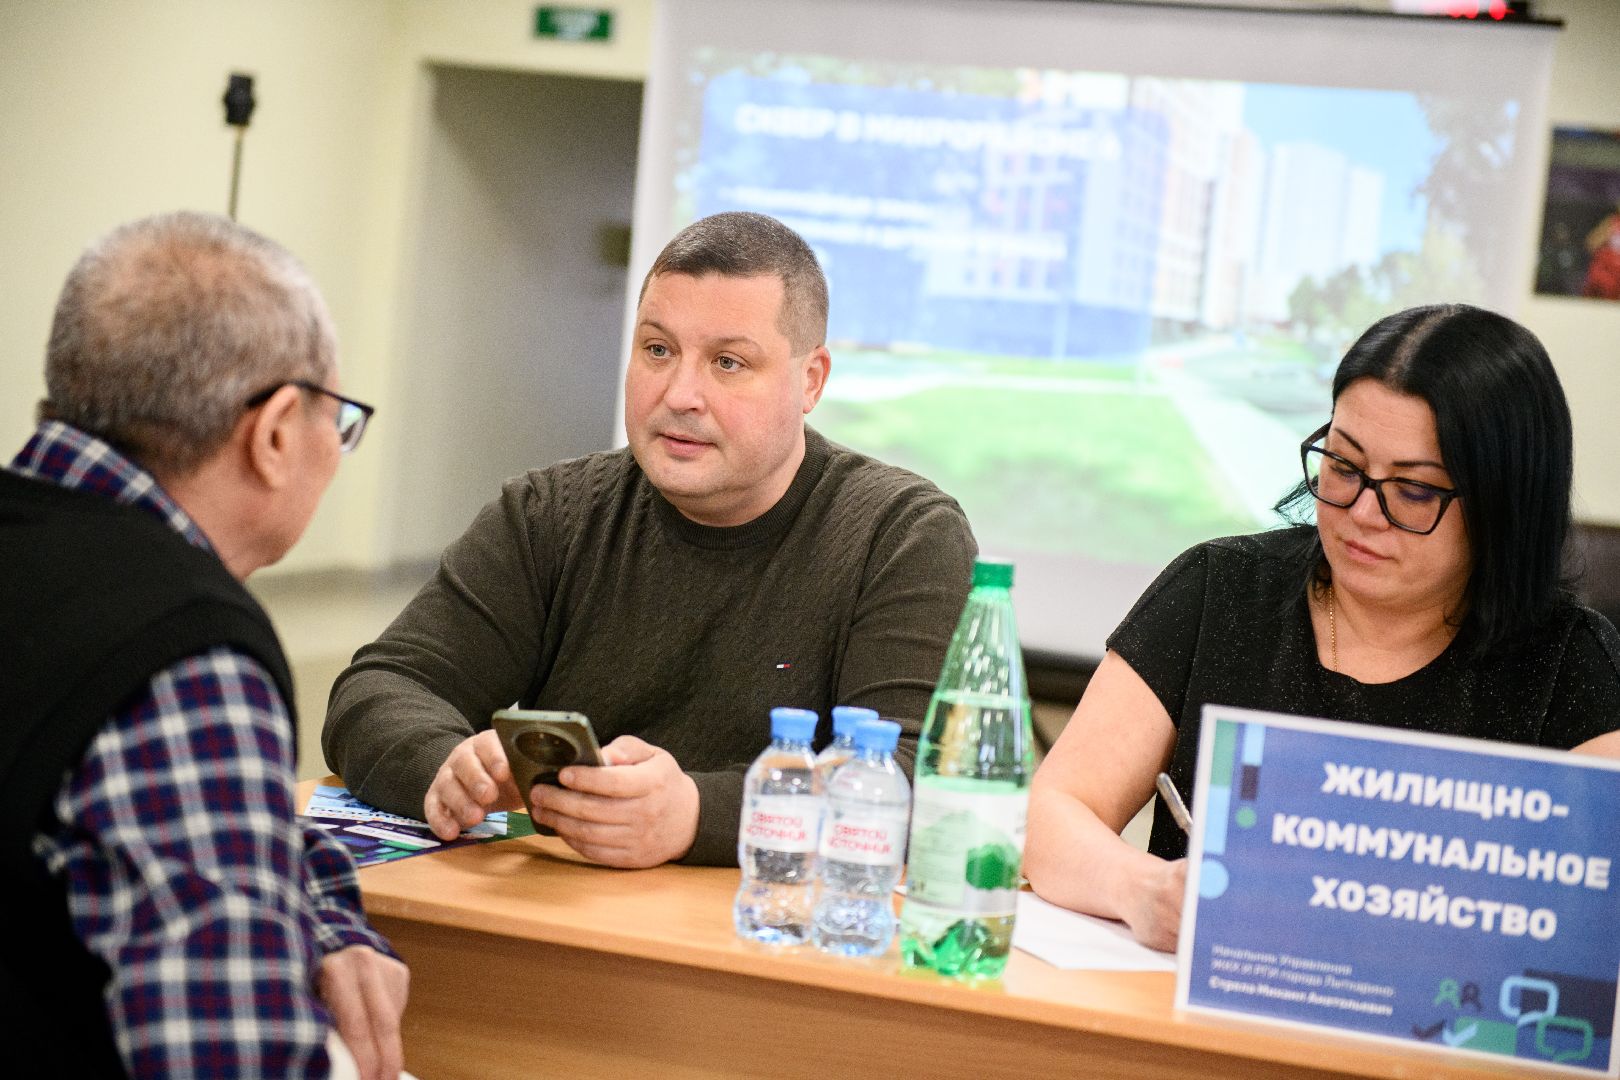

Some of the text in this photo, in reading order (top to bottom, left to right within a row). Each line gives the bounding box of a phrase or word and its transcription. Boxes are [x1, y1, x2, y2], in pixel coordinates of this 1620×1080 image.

[1321, 762, 1569, 821] ЖИЛИЩНО-
[1271, 813, 1612, 890] КОММУНАЛЬНОЕ
[1308, 875, 1558, 940] ХОЗЯЙСТВО
